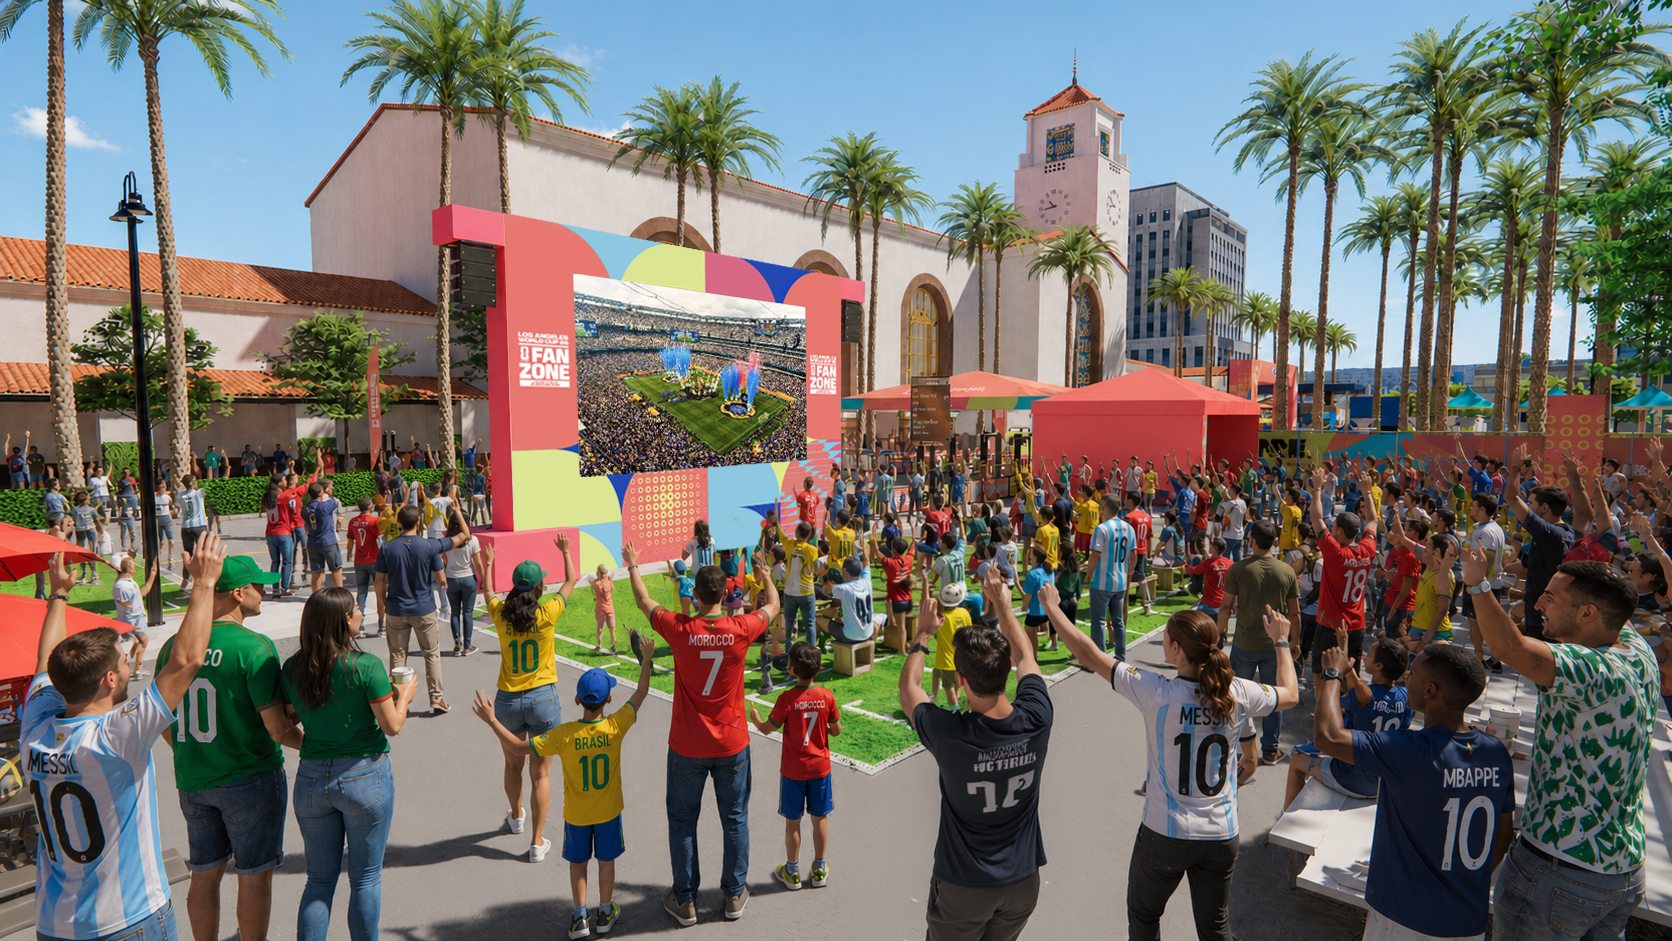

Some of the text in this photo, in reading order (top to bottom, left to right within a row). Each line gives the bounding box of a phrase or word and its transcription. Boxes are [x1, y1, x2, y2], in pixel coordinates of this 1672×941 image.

[535, 333, 569, 341] ANGELES
[519, 363, 570, 380] ZONE
[532, 347, 569, 364] FAN
[817, 365, 836, 378] FAN
[810, 377, 837, 389] ZONE
[1342, 569, 1368, 603] 18
[508, 639, 539, 674] 10
[688, 633, 735, 647] MOROCCO
[699, 650, 724, 696] 7
[177, 677, 217, 743] 10
[575, 734, 612, 751] BRASIL
[803, 711, 819, 747] 7
[579, 753, 610, 792] 10
[1174, 733, 1230, 797] 10
[1443, 766, 1500, 789] MBAPPE
[29, 780, 106, 864] 10
[1441, 795, 1496, 871] 10
